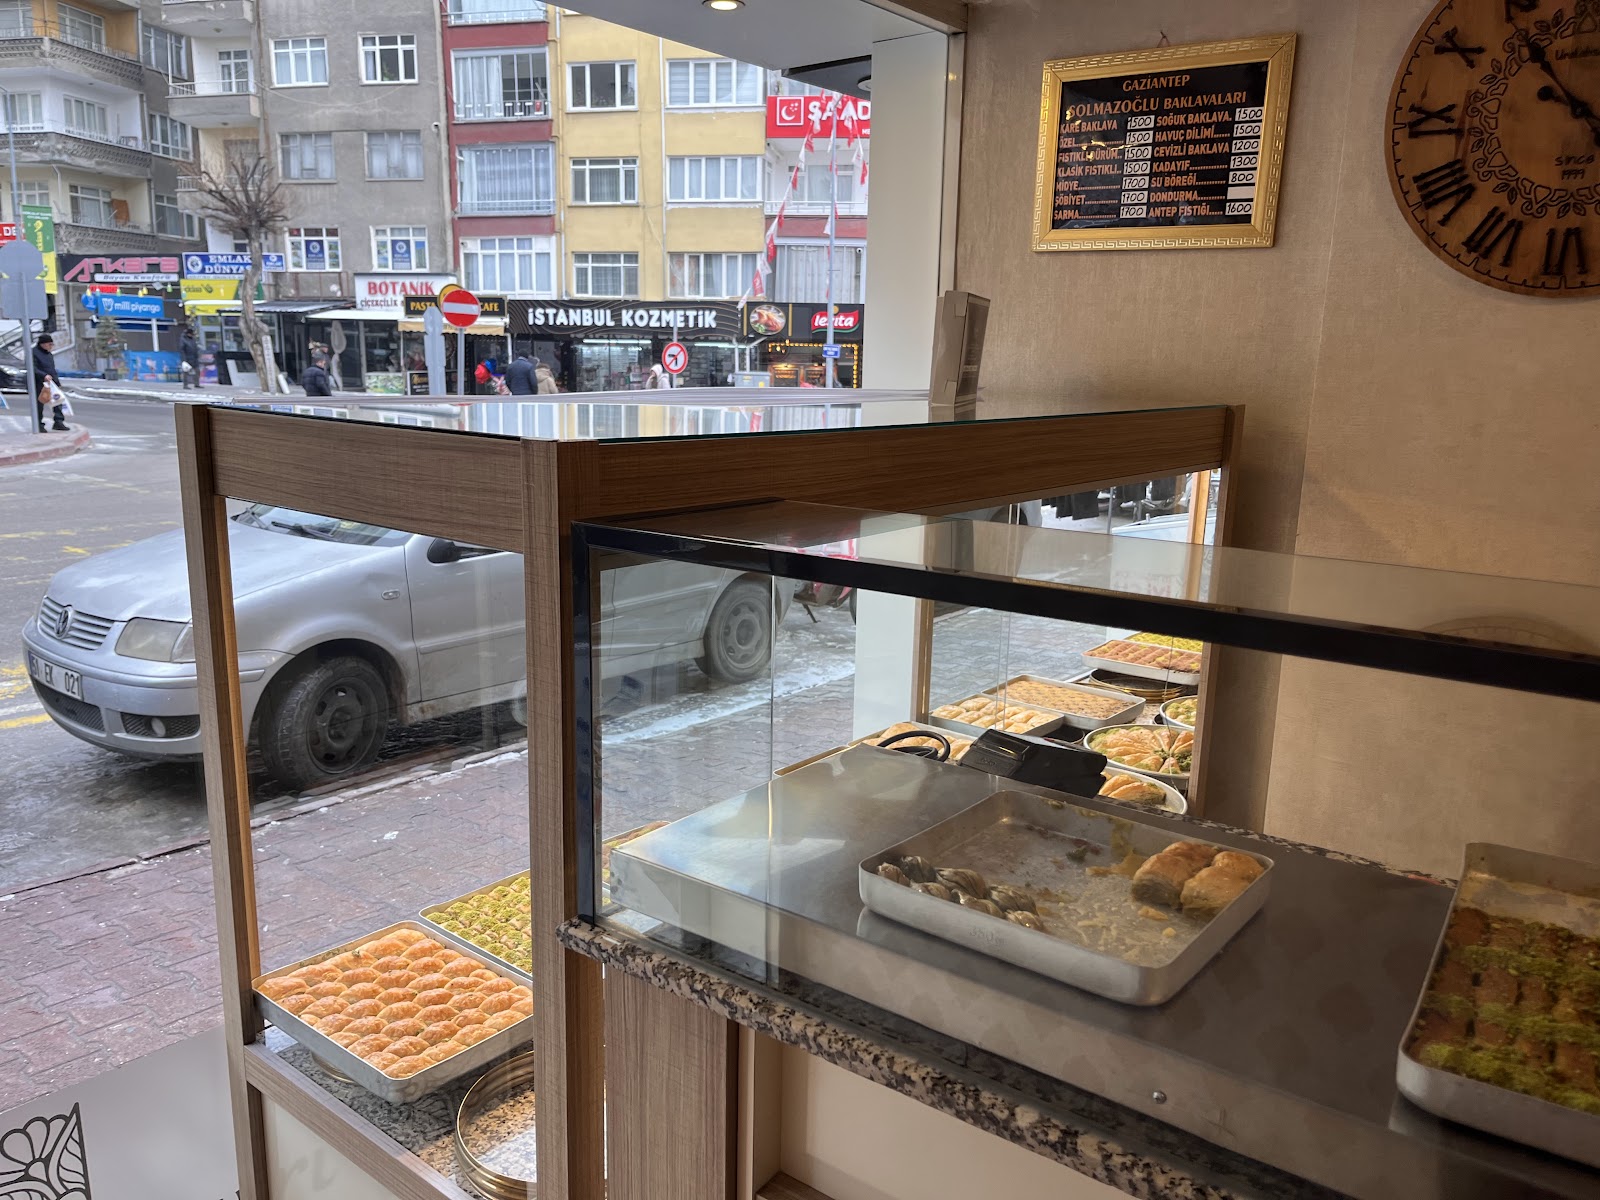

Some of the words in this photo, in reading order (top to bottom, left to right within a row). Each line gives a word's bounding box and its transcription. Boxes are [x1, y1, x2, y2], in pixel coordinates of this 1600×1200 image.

[1123, 75, 1190, 92] GAZİANTEP
[1068, 95, 1159, 118] SOLMAZOĞLU
[1163, 91, 1247, 110] BAKLAVALARI
[1156, 113, 1187, 126] SOĞUK
[1237, 108, 1263, 120] 1500
[1060, 122, 1080, 134] KARE
[1081, 120, 1118, 132] BAKLAVA
[1127, 116, 1152, 129] 1500
[1126, 132, 1151, 143] 1500
[1155, 130, 1185, 142] HAVUÇ
[1186, 125, 1215, 140] DİLİMİ
[1235, 125, 1260, 135] 1500
[1126, 147, 1149, 159] 1500
[1154, 143, 1187, 157] CEVİZLİ
[1188, 142, 1230, 156] BAKLAVA
[1233, 140, 1259, 151] 1200
[1057, 164, 1083, 177] KLASİK
[1085, 164, 1117, 176] FISTIKLI
[1124, 162, 1149, 174] 1500
[1152, 160, 1190, 173] KADAYIF
[1232, 156, 1257, 168] 1300
[1056, 180, 1079, 192] MİDYE
[1123, 177, 1146, 188] 1700
[1151, 177, 1163, 188] SU
[1163, 173, 1197, 187] BÖREĞİ
[1231, 173, 1254, 183] 800
[1055, 193, 1086, 207] ŞÖBİYET
[1122, 192, 1145, 204] 1700
[1150, 190, 1198, 203] DONDURMA
[1054, 209, 1079, 220] SARMA
[1121, 207, 1144, 217] 1700
[1149, 206, 1178, 218] ANTEP
[1179, 203, 1210, 217] FISTIĞI
[1227, 203, 1252, 214] 1600
[209, 255, 252, 264] EMLAK
